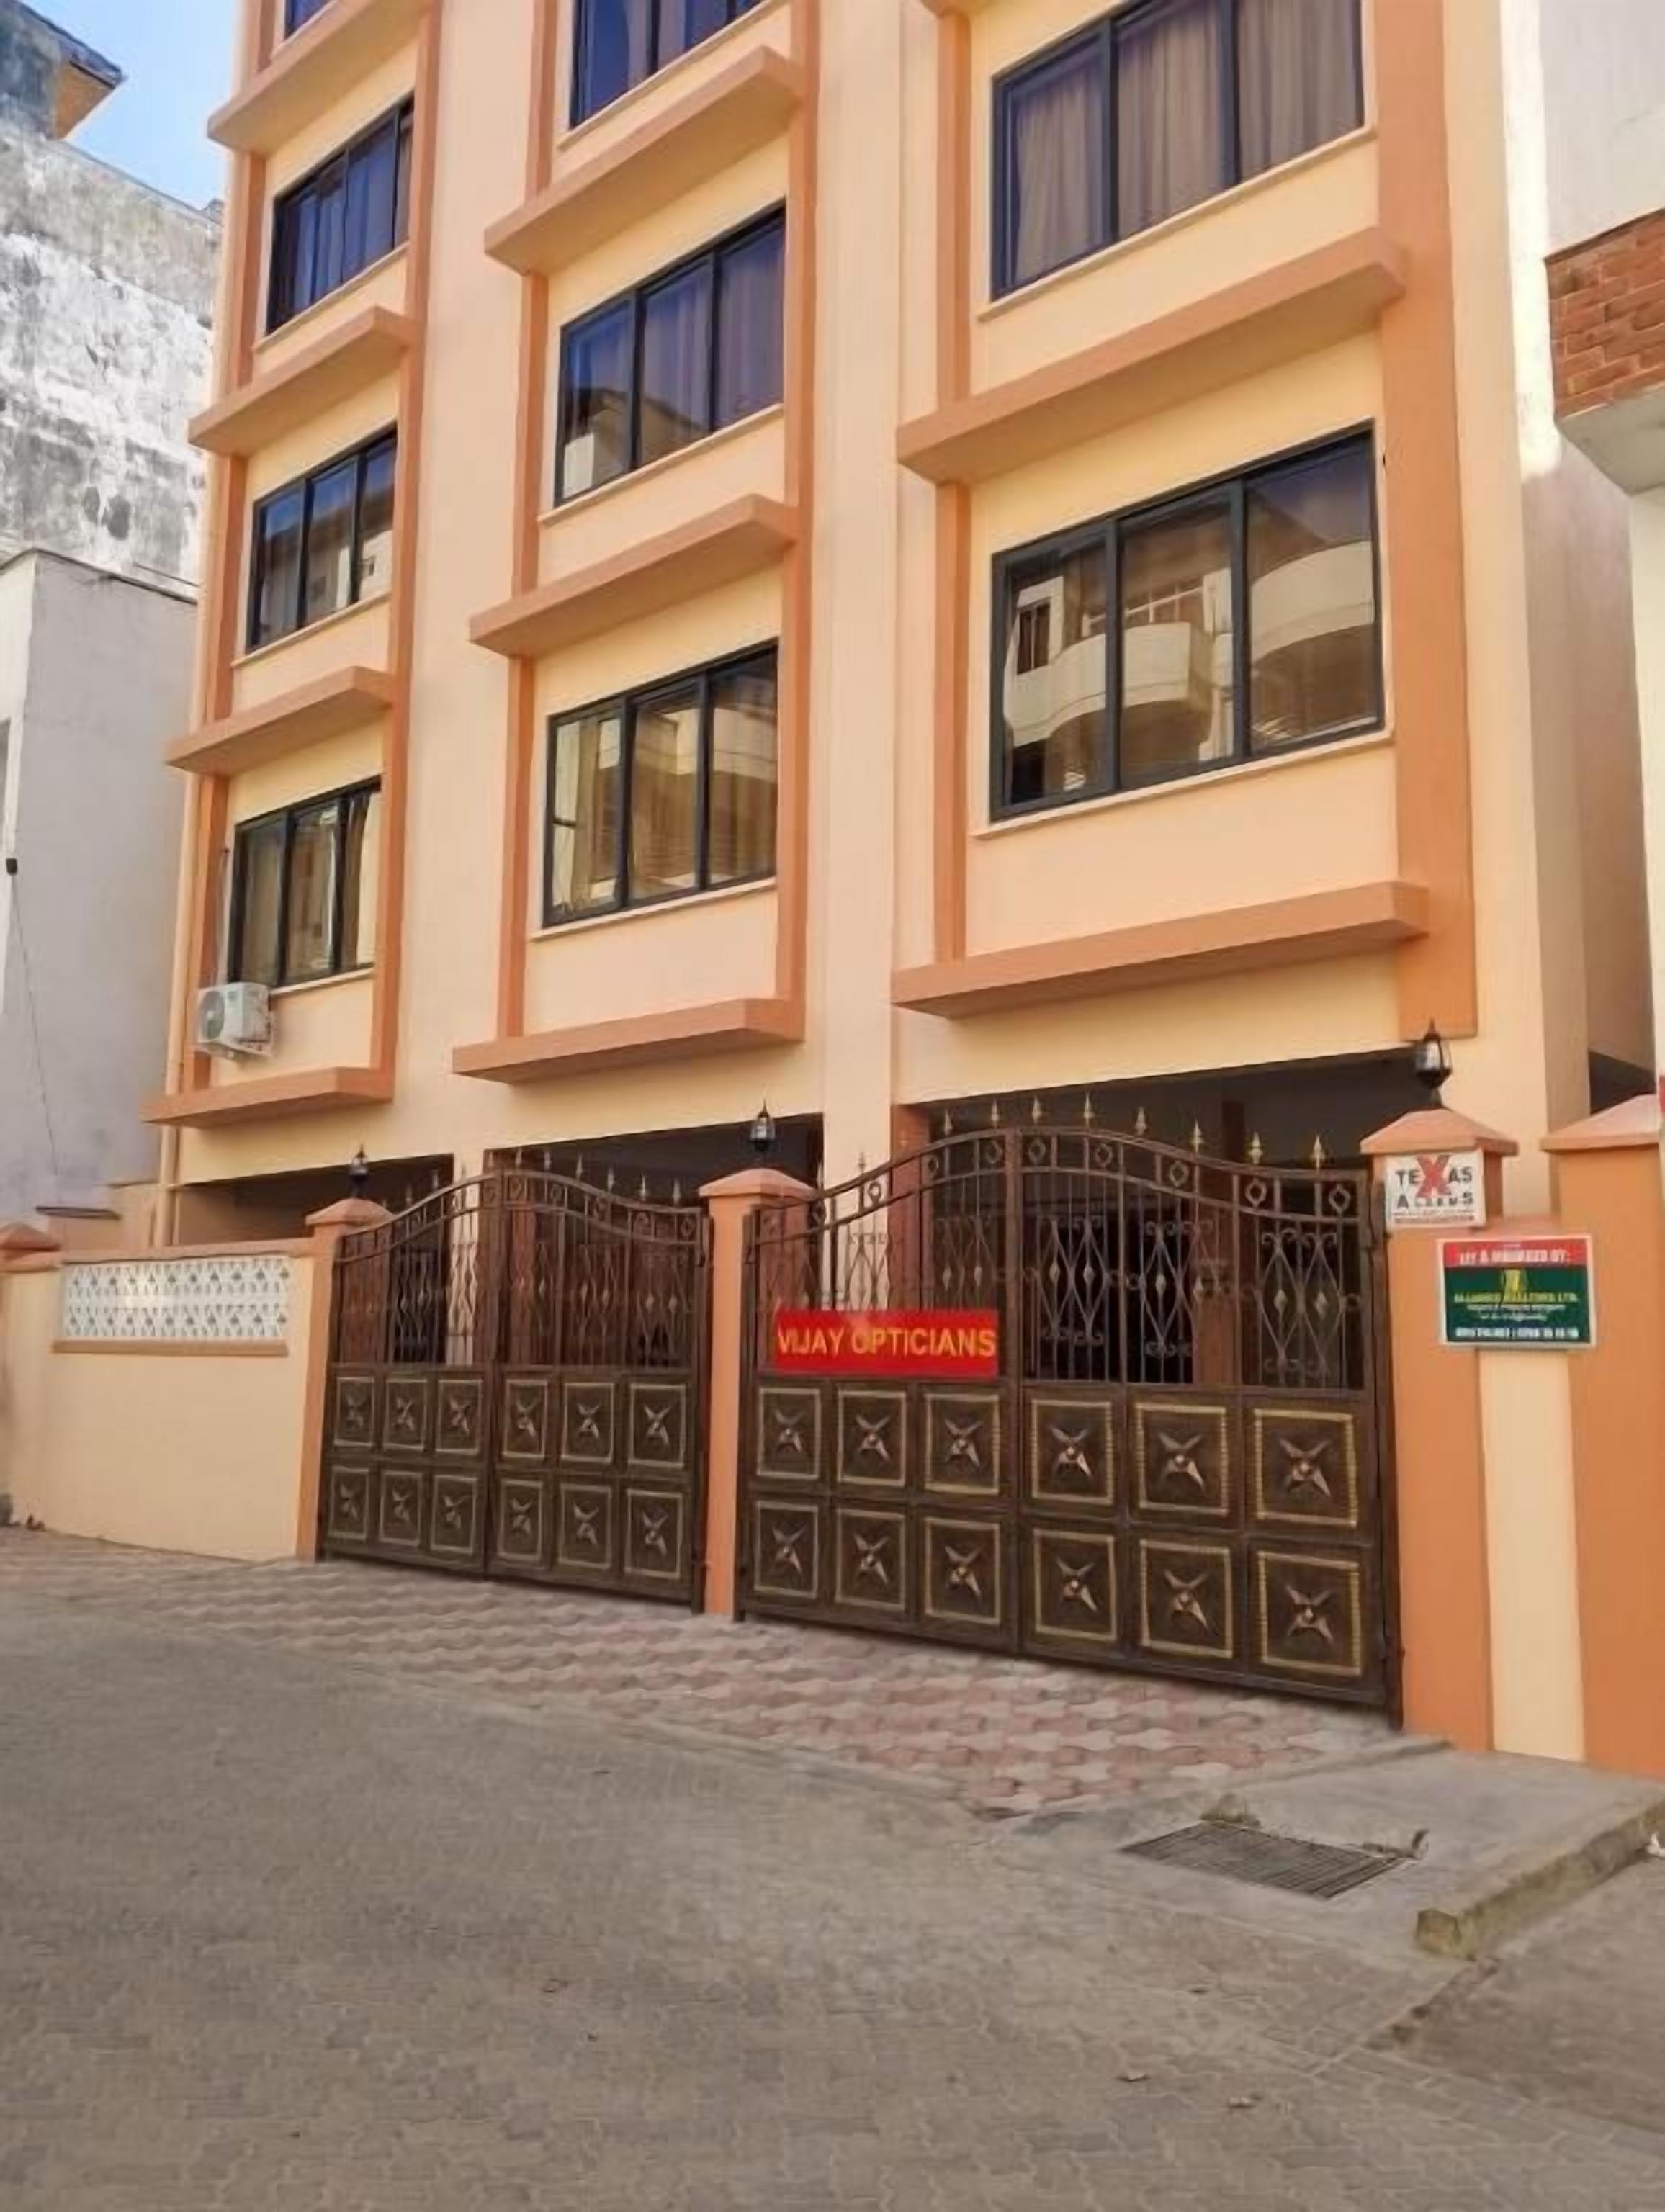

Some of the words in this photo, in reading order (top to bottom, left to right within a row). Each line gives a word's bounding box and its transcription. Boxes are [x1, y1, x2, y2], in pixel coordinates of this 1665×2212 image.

[1395, 1154, 1473, 1198] TEXAS
[778, 1327, 844, 1357] VIJAY
[851, 1327, 997, 1357] OPTICIANS
